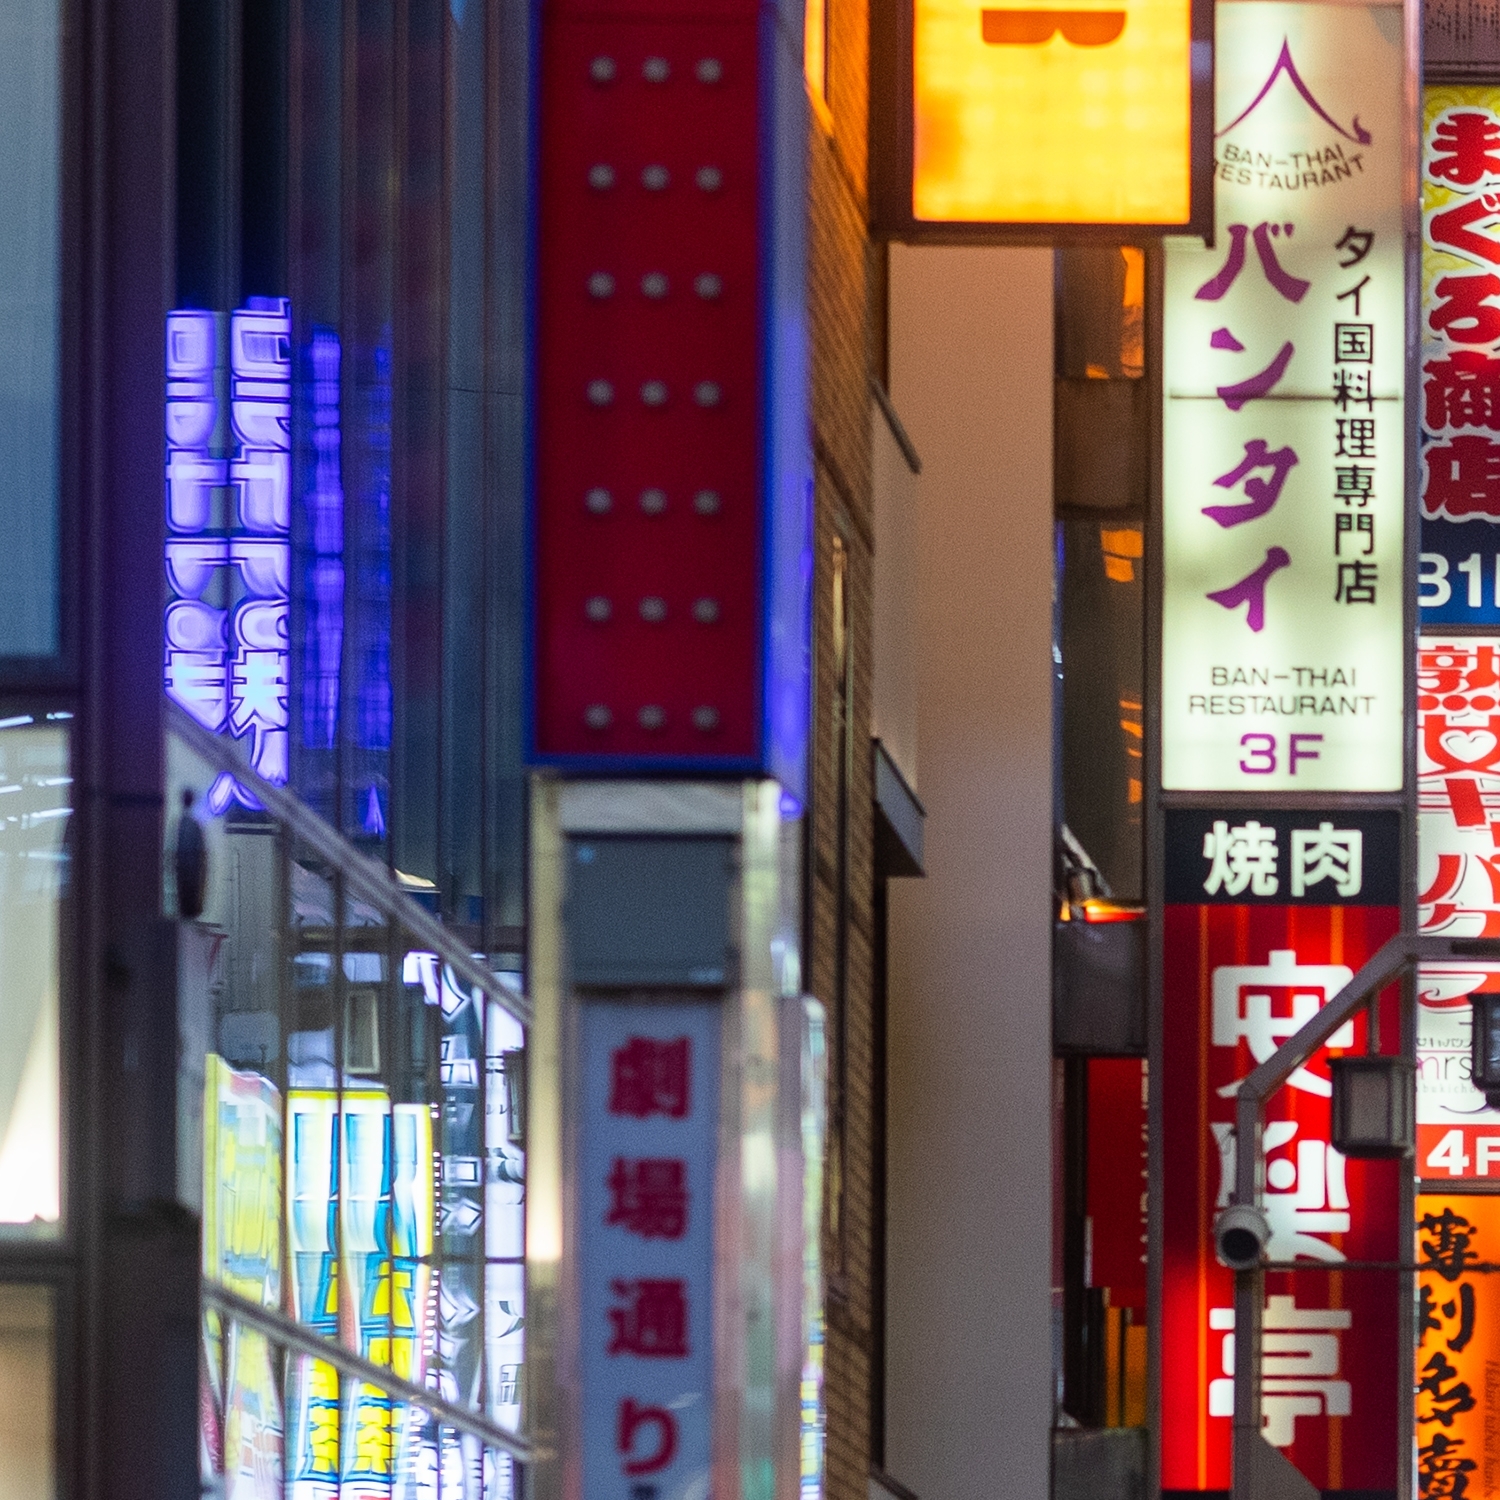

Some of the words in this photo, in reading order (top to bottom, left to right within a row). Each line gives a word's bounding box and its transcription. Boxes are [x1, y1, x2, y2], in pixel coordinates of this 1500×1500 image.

[1215, 156, 1365, 191] ESTAURANT
[1223, 143, 1346, 172] BAN-THAI
[1194, 221, 1312, 634] バンタイ
[1334, 225, 1379, 605] タイ国料理専門店
[1210, 665, 1357, 687] BAN-THAI
[1188, 694, 1376, 716] RESTAURANT
[1239, 732, 1325, 776] 3F
[1203, 820, 1364, 899] 焼肉
[607, 1034, 693, 1476] 劇場通り
